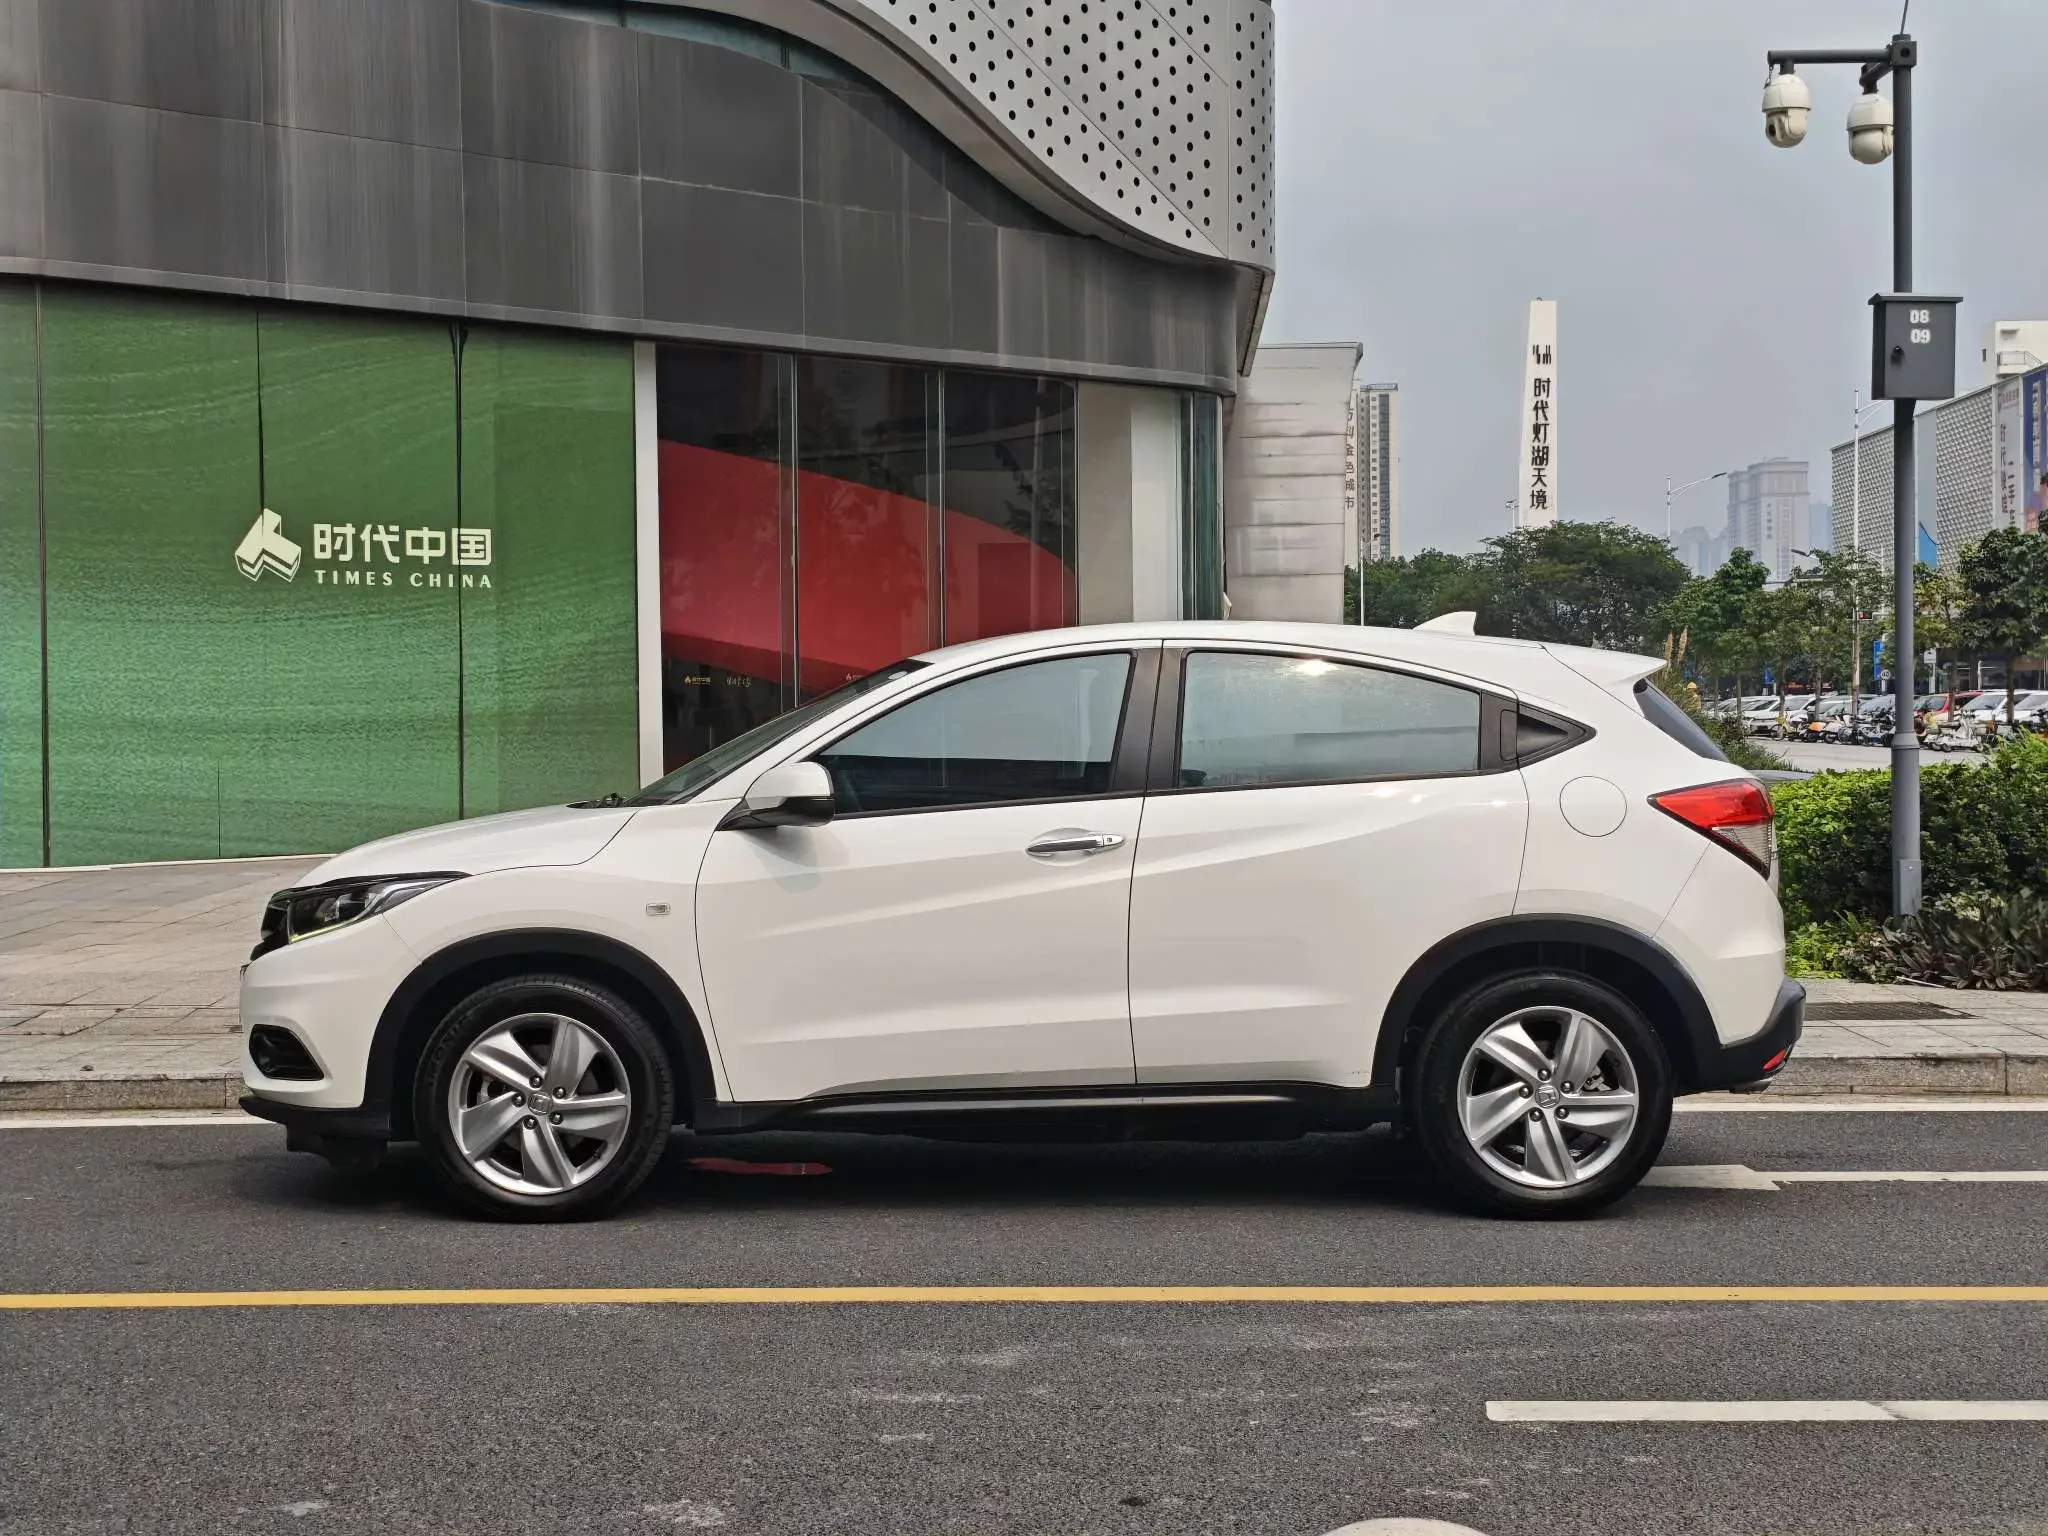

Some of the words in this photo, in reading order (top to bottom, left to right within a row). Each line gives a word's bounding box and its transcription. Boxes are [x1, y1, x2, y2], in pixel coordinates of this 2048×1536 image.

[1909, 309, 1930, 324] 08
[1910, 328, 1931, 344] 09
[1530, 377, 1551, 510] 时代灯湖天境
[313, 523, 492, 566] 时代中国
[314, 569, 394, 587] TIMES
[410, 572, 493, 589] CHINA
